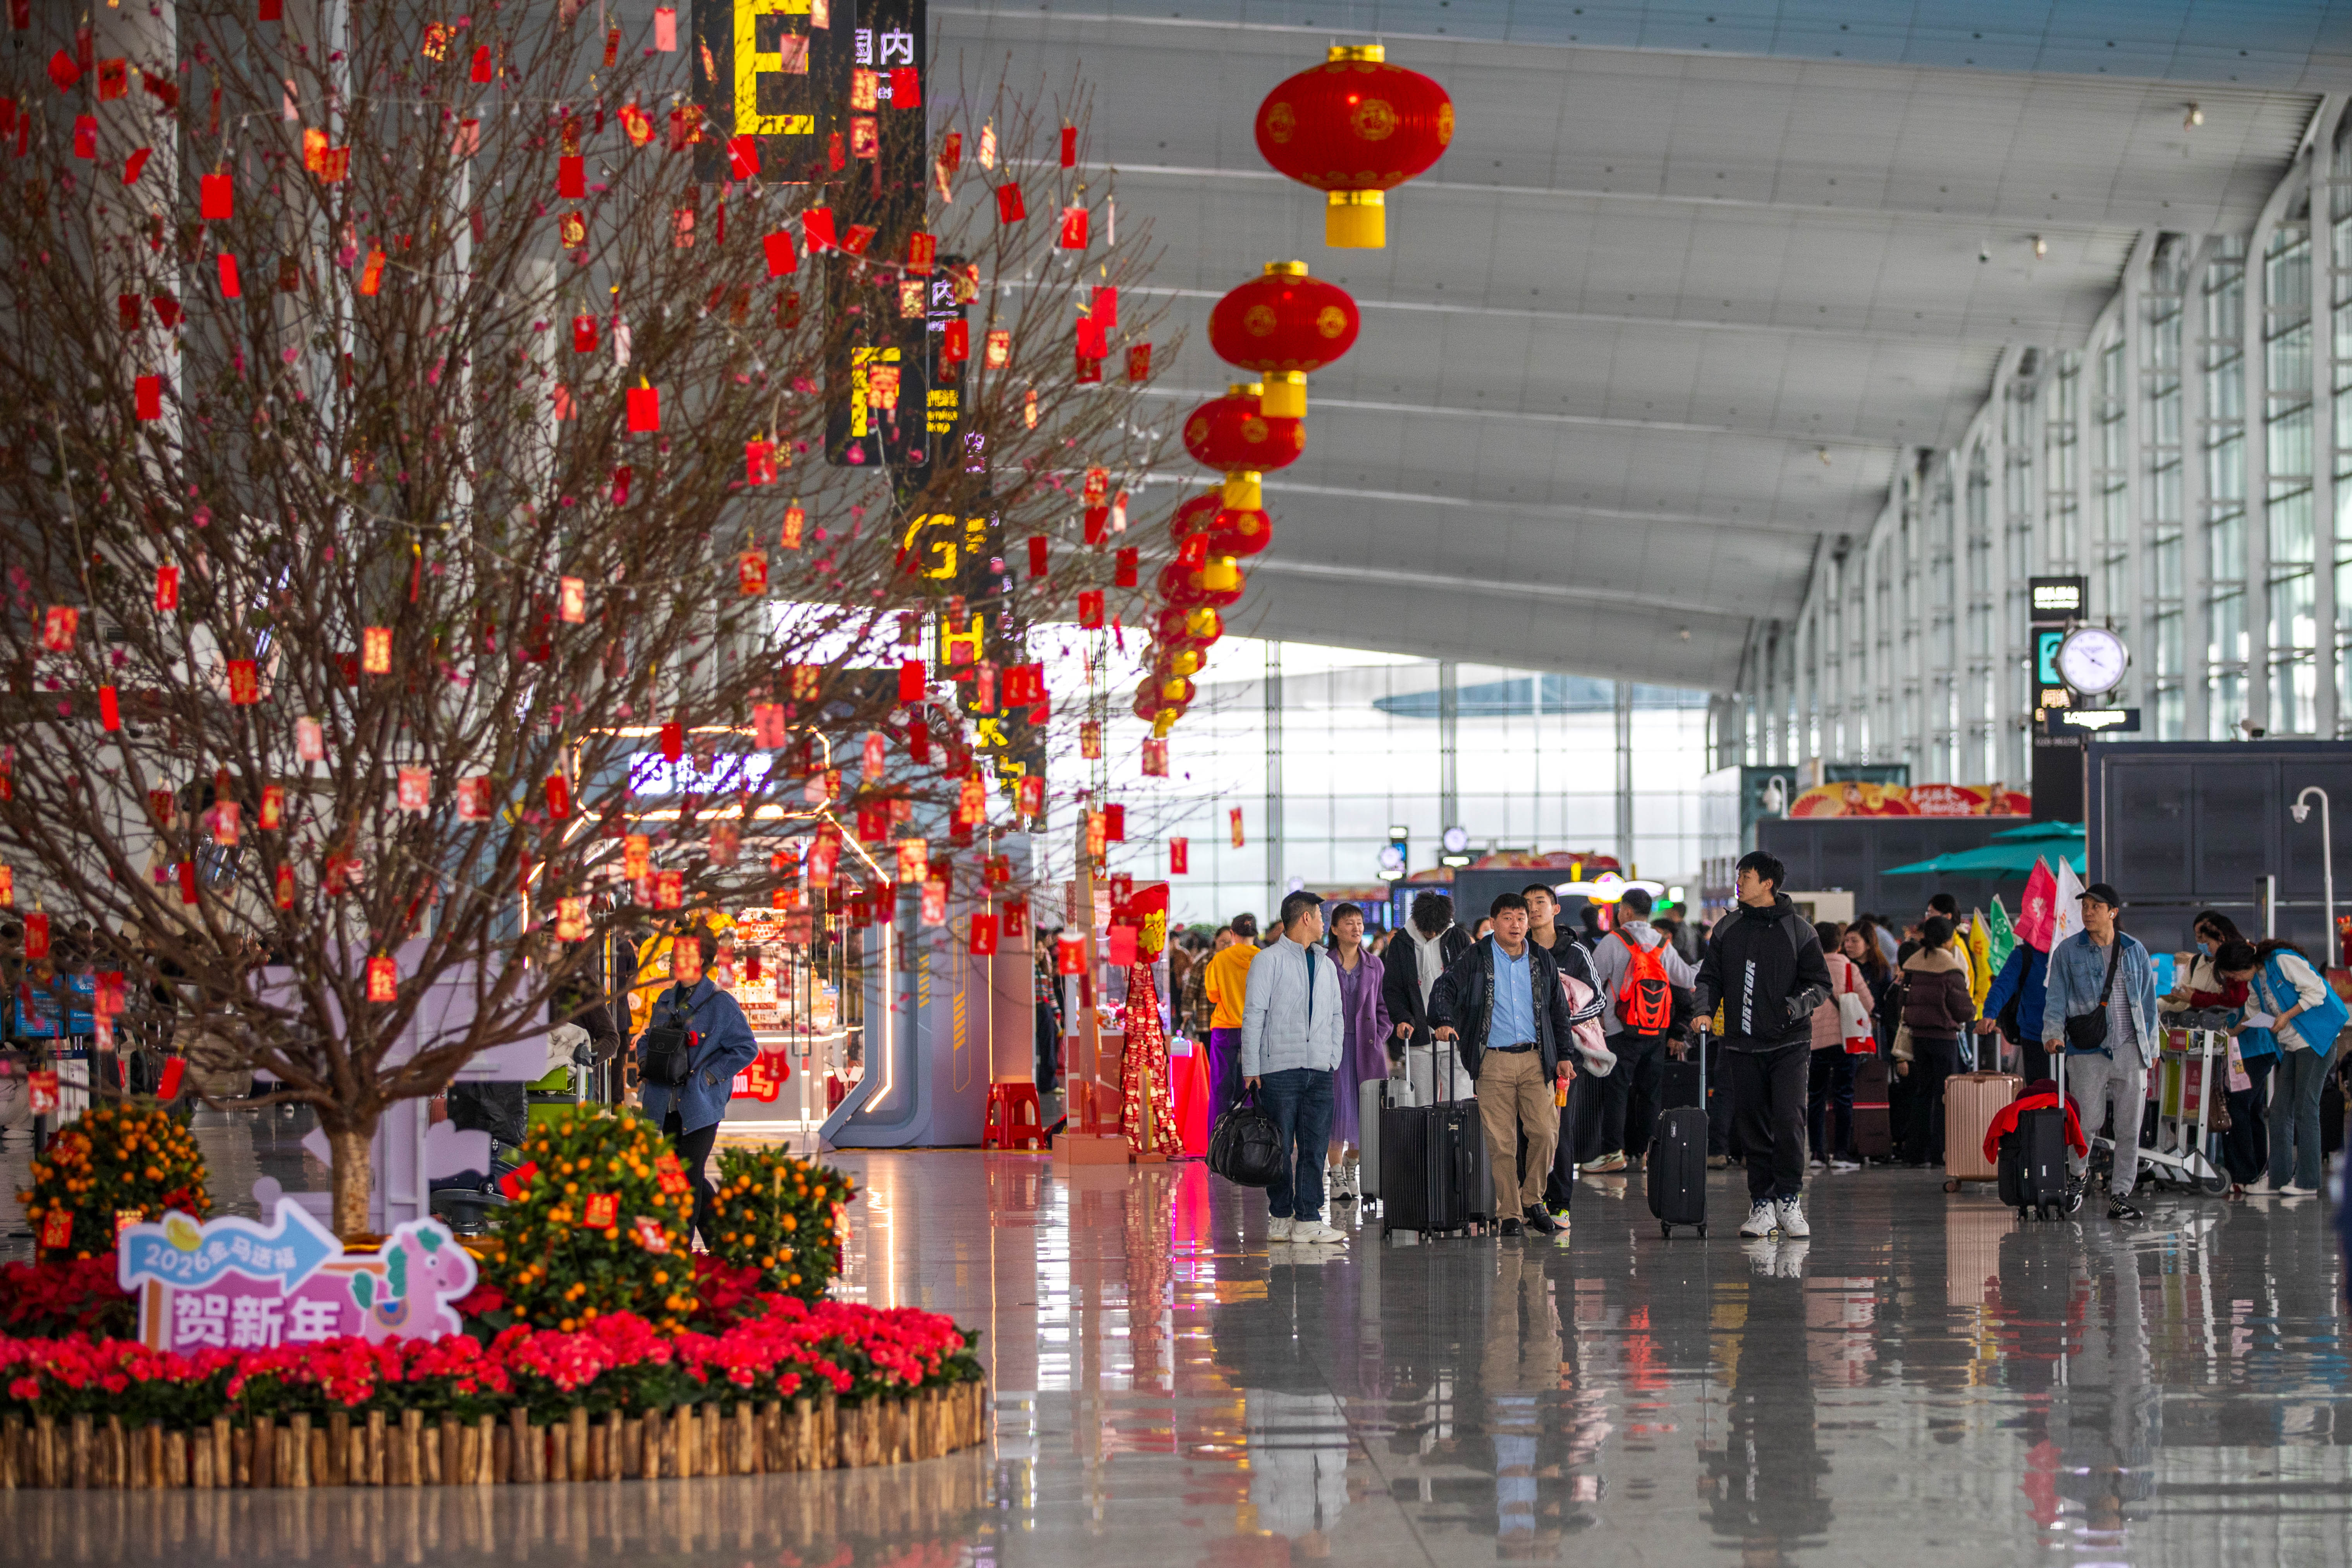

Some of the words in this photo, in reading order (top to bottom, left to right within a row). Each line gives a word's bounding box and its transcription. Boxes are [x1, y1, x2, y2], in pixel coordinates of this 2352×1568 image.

[734, 0, 814, 134] E
[851, 347, 901, 437] F
[904, 513, 957, 580] G
[942, 612, 984, 665] H
[175, 1293, 341, 1348] 贺新年
